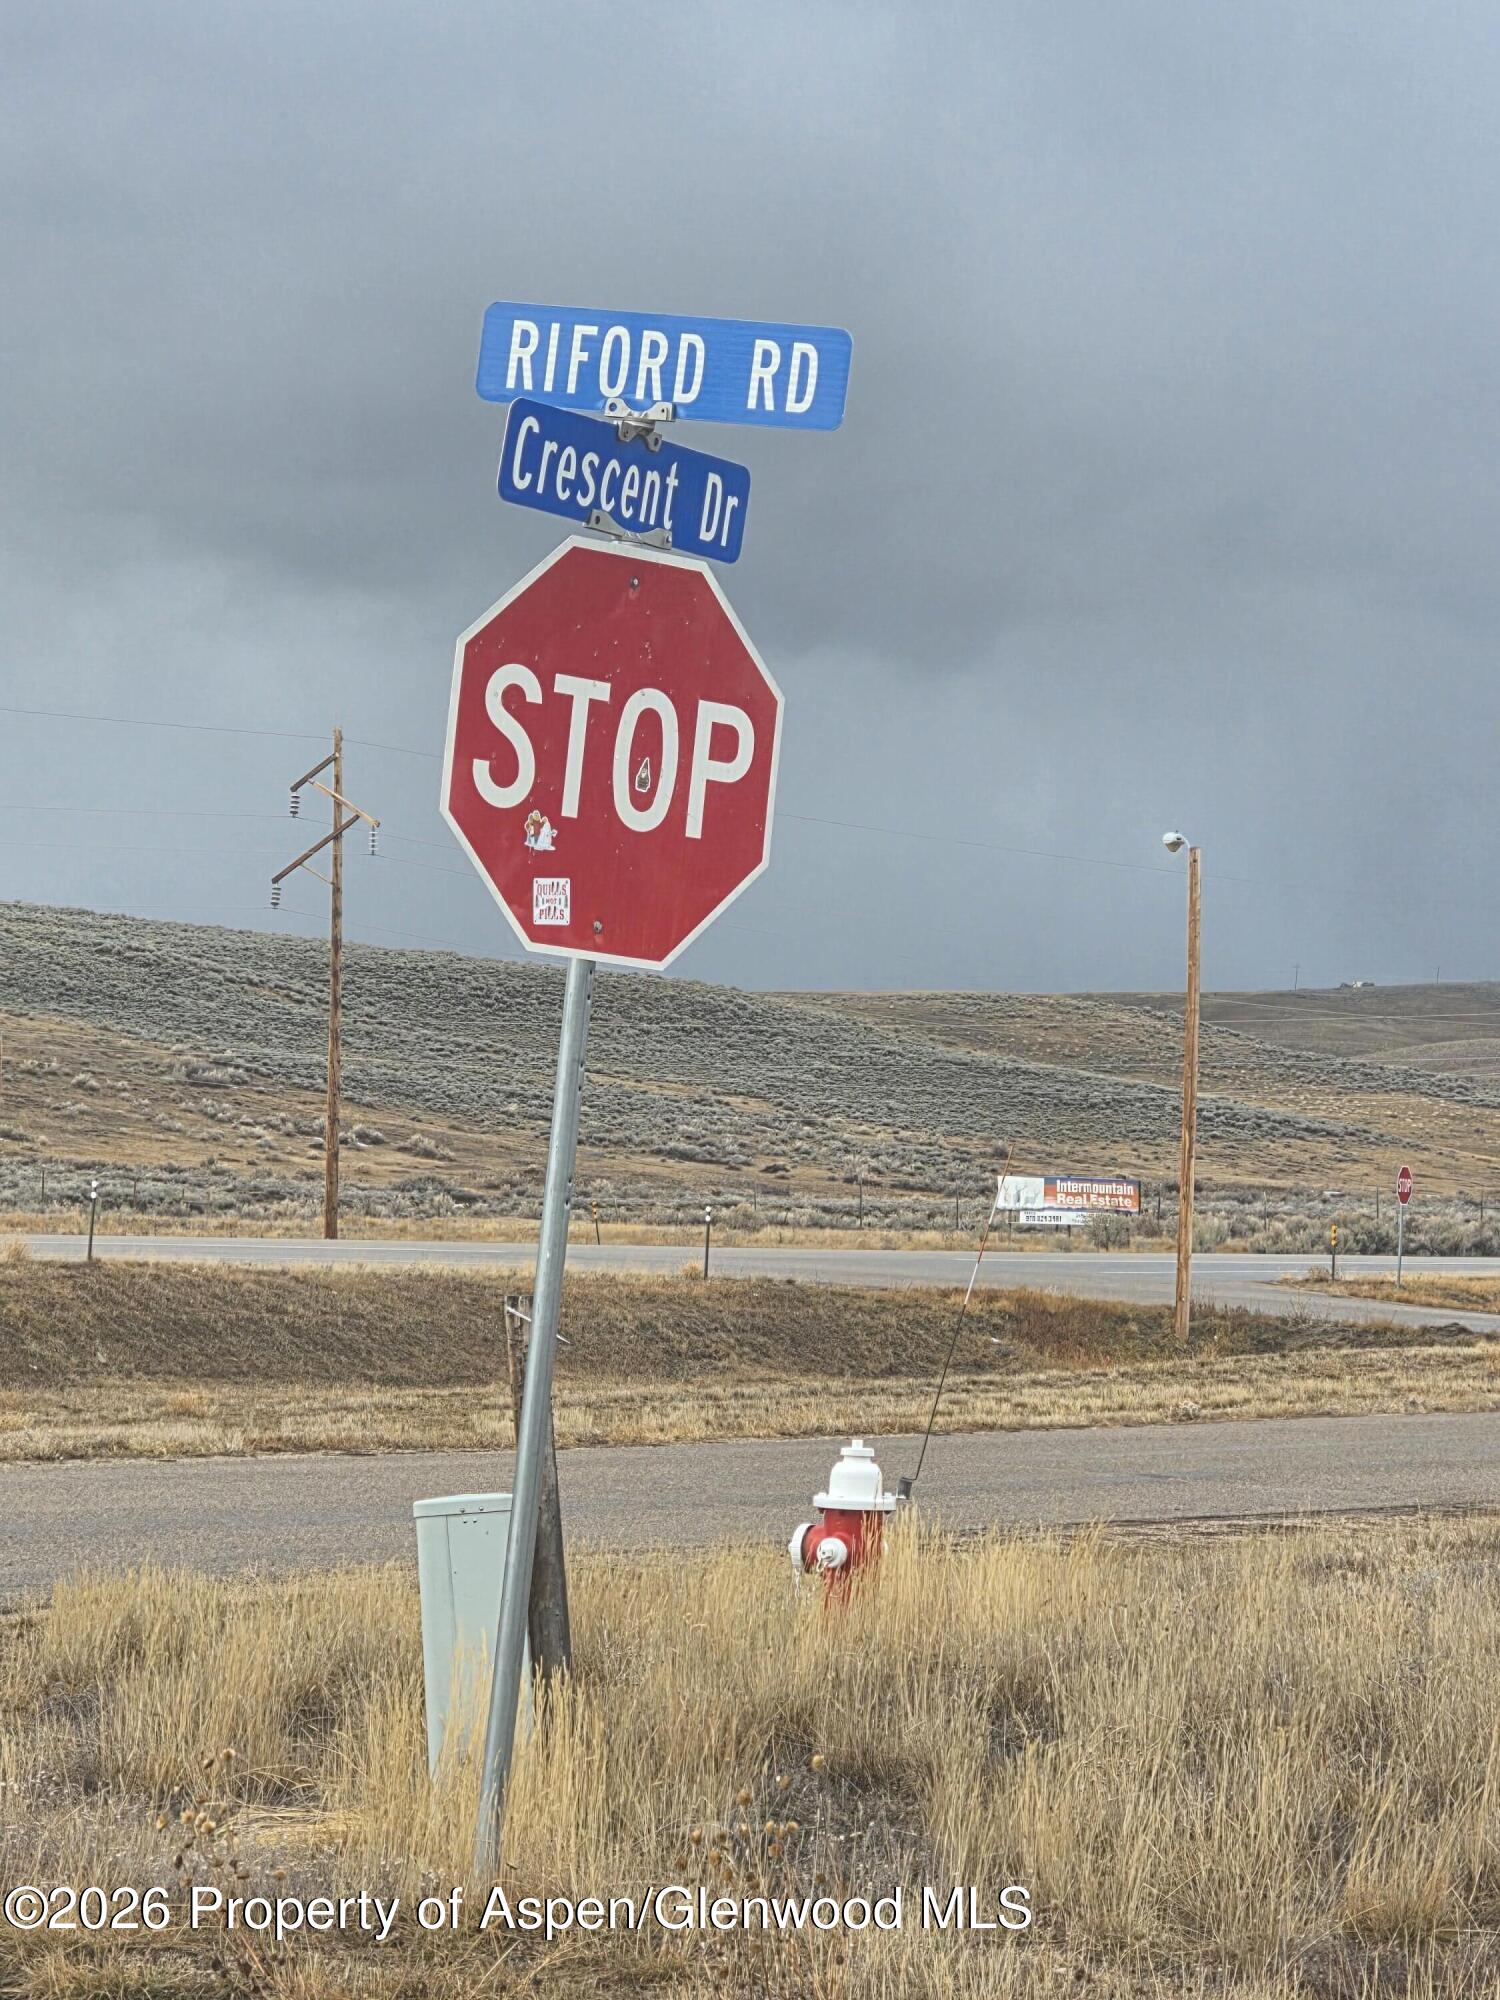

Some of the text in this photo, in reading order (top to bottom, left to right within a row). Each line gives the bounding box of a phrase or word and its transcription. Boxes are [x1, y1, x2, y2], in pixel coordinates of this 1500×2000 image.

[505, 319, 819, 413] RIFORD RD
[512, 416, 739, 547] Crescent Dr
[472, 663, 755, 839] STOP
[538, 906, 565, 920] PILLS
[1056, 1179, 1134, 1195] Intermountain
[1398, 1178, 1411, 1192] STOP
[1056, 1193, 1133, 1207] Real Estate
